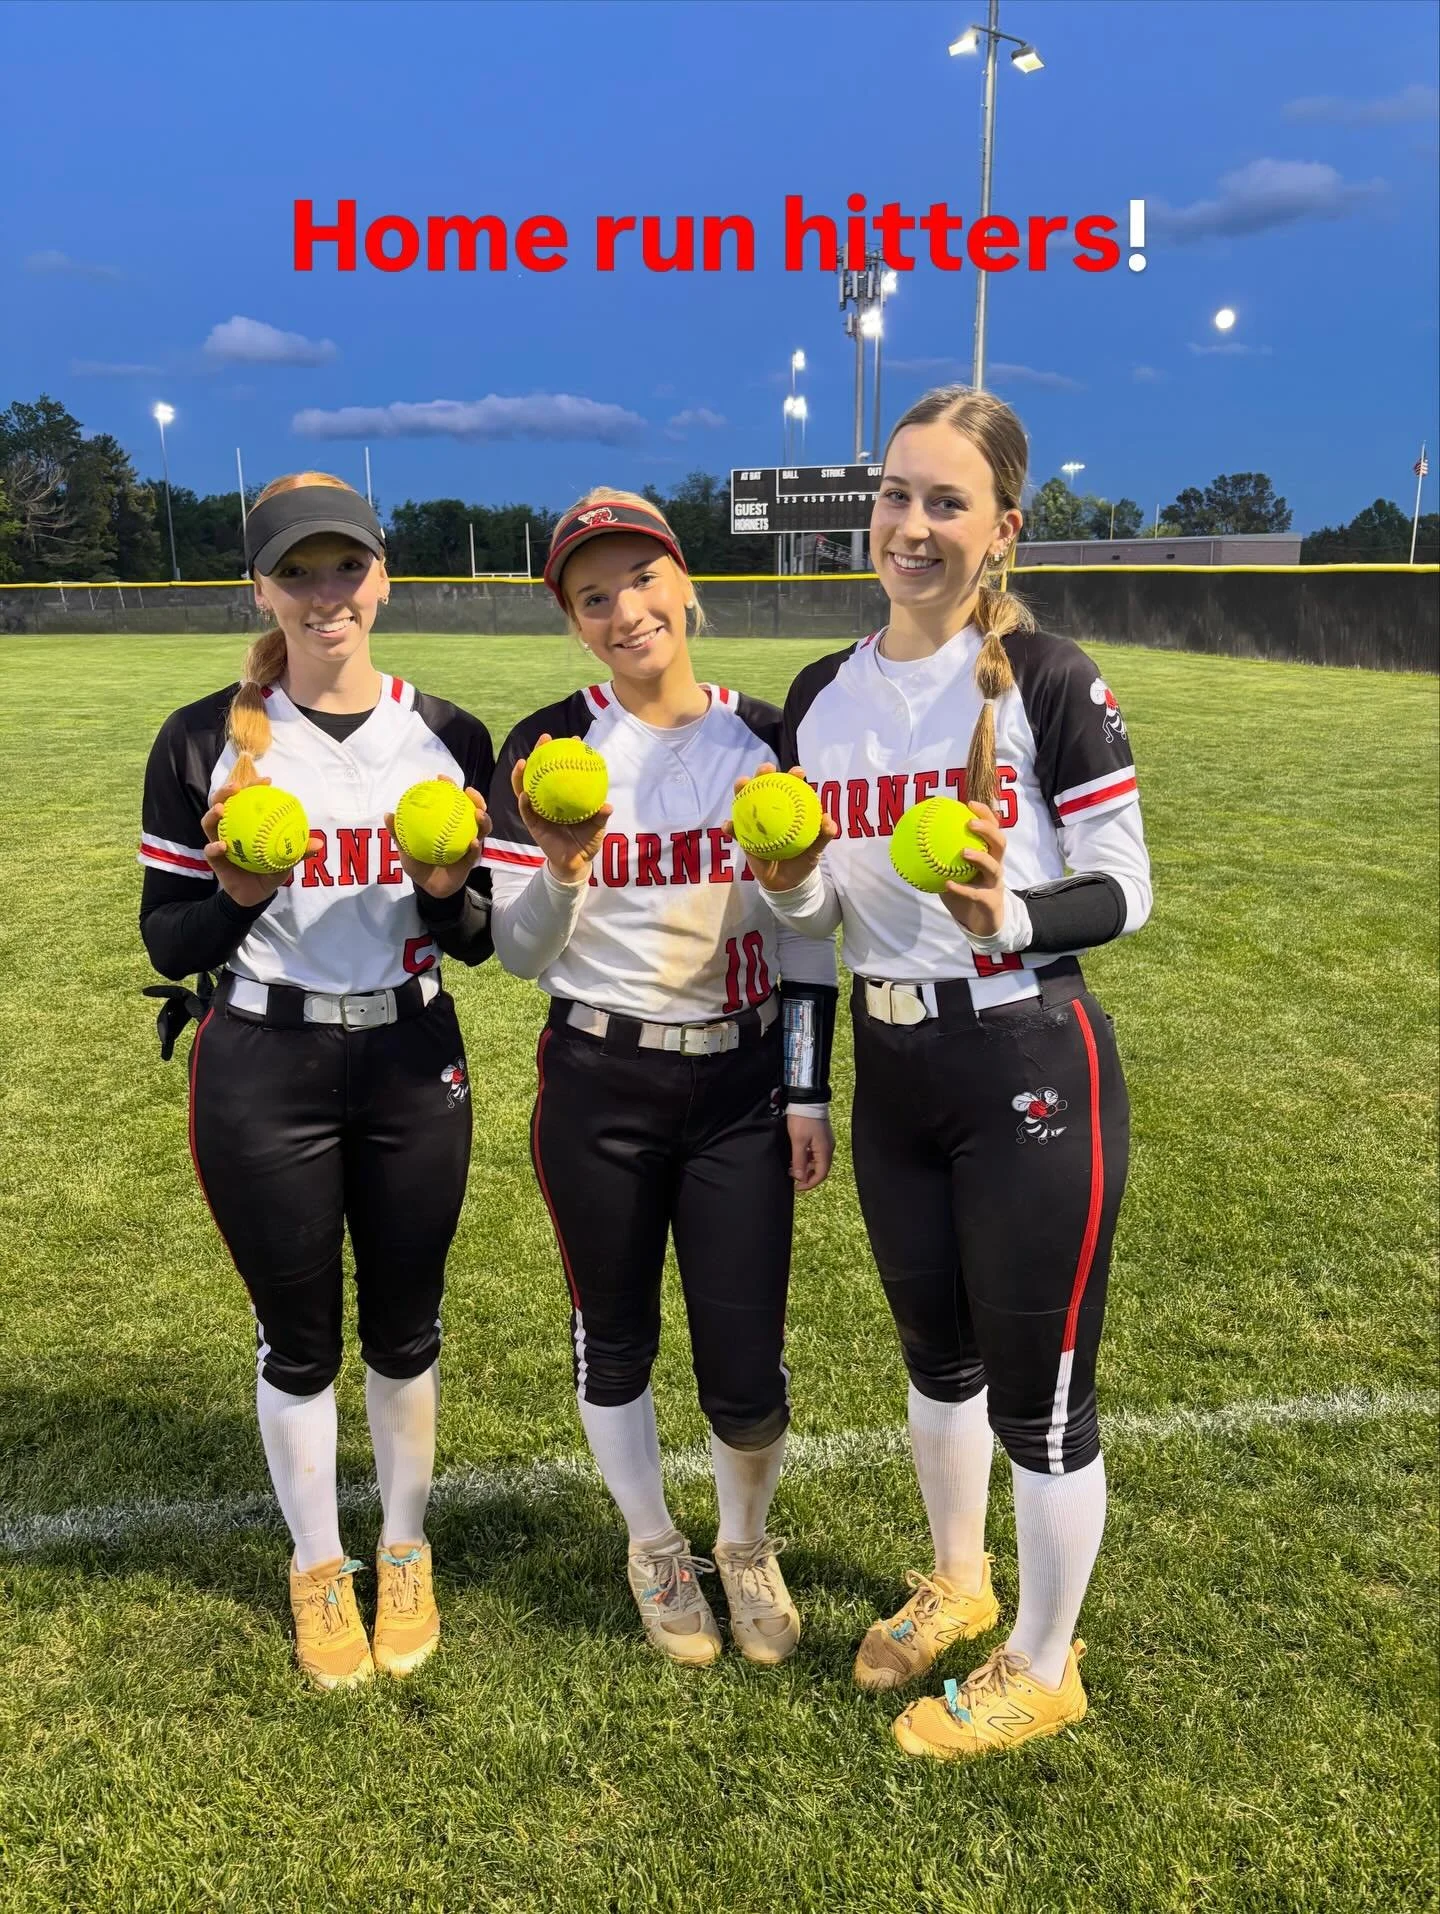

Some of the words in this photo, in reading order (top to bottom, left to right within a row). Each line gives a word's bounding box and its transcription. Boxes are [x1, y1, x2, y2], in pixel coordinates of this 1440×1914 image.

[782, 470, 800, 480] BALL
[821, 468, 846, 478] STRIKE
[867, 466, 882, 477] OUT
[734, 502, 769, 516] GUEST
[734, 517, 769, 531] HORNETS
[588, 828, 758, 888] ORNE
[722, 930, 771, 1014] 10
